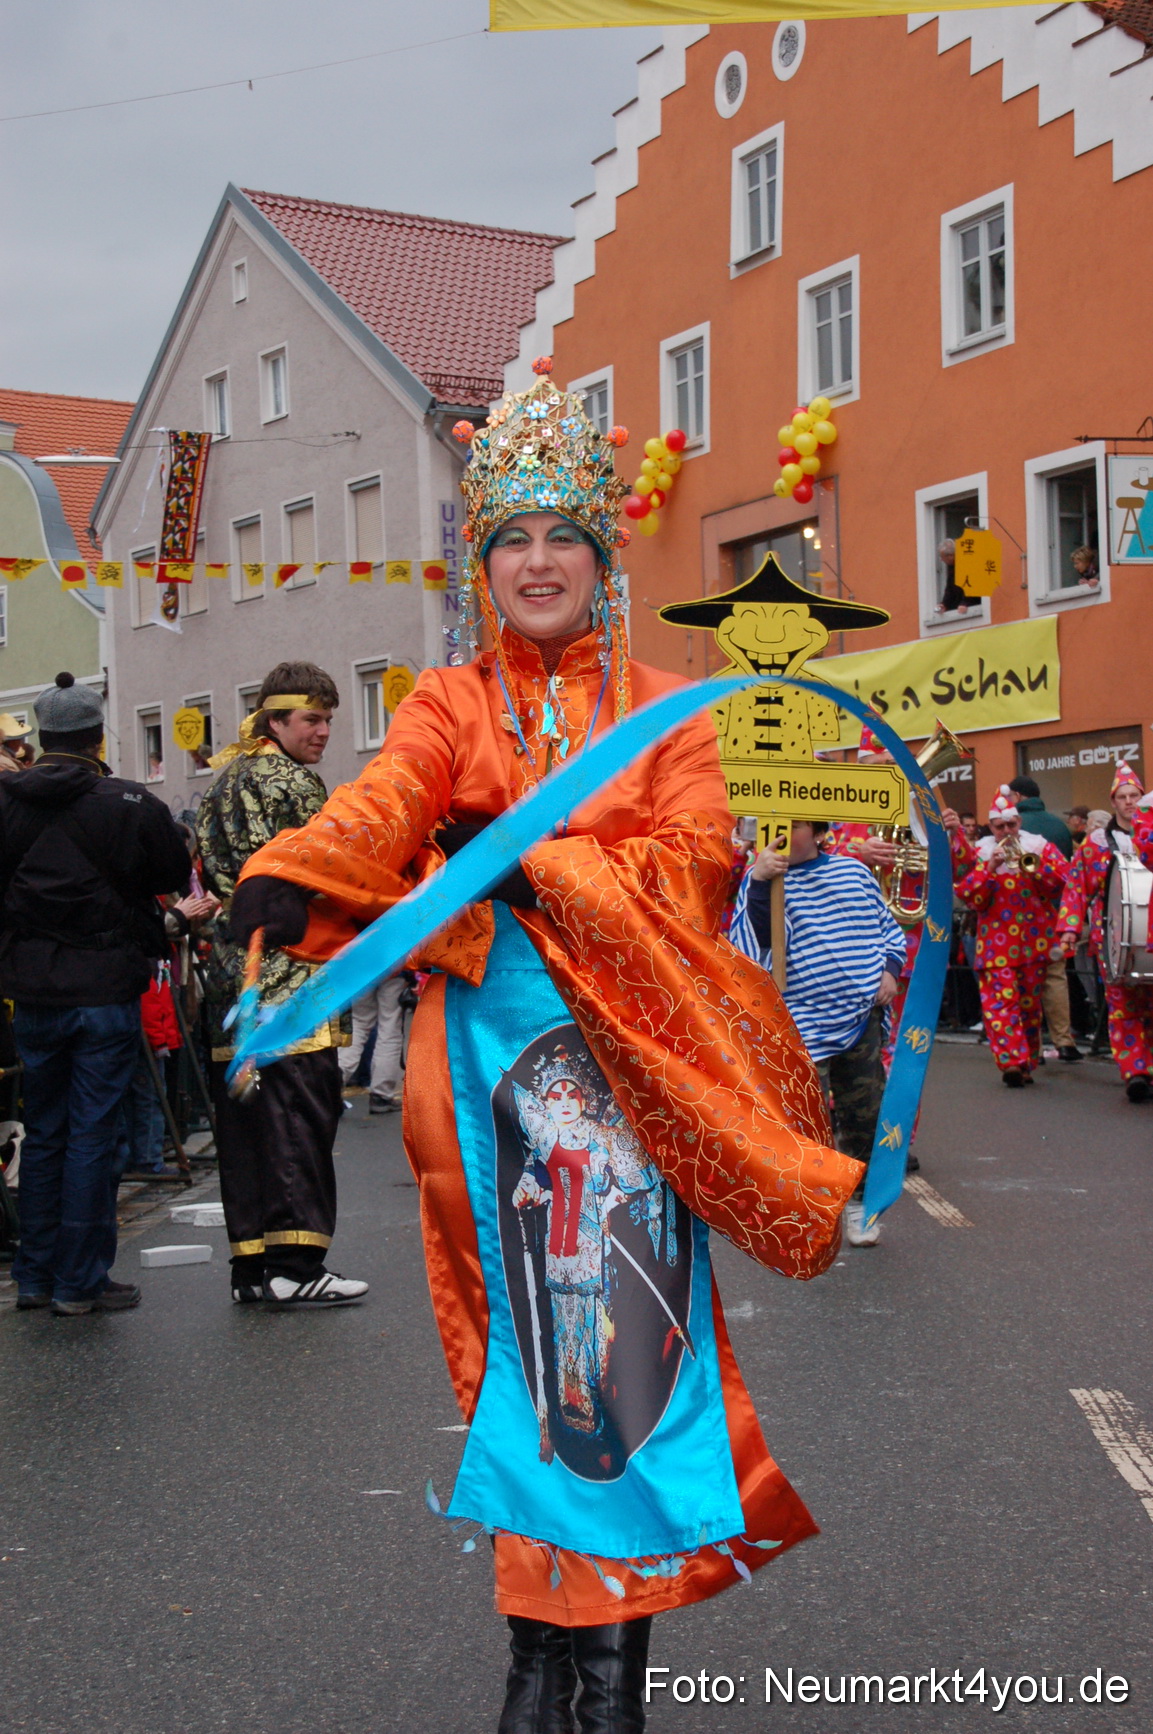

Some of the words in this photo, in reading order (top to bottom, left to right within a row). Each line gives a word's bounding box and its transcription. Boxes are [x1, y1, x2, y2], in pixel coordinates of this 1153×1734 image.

[902, 686, 921, 711] a
[930, 657, 1048, 706] Schau
[1028, 760, 1045, 772] 100
[1046, 755, 1076, 770] JAHRE
[1078, 743, 1139, 766] GÖTZ
[725, 779, 773, 800] pelle
[779, 780, 890, 809] Riedenburg
[761, 823, 788, 850] 15
